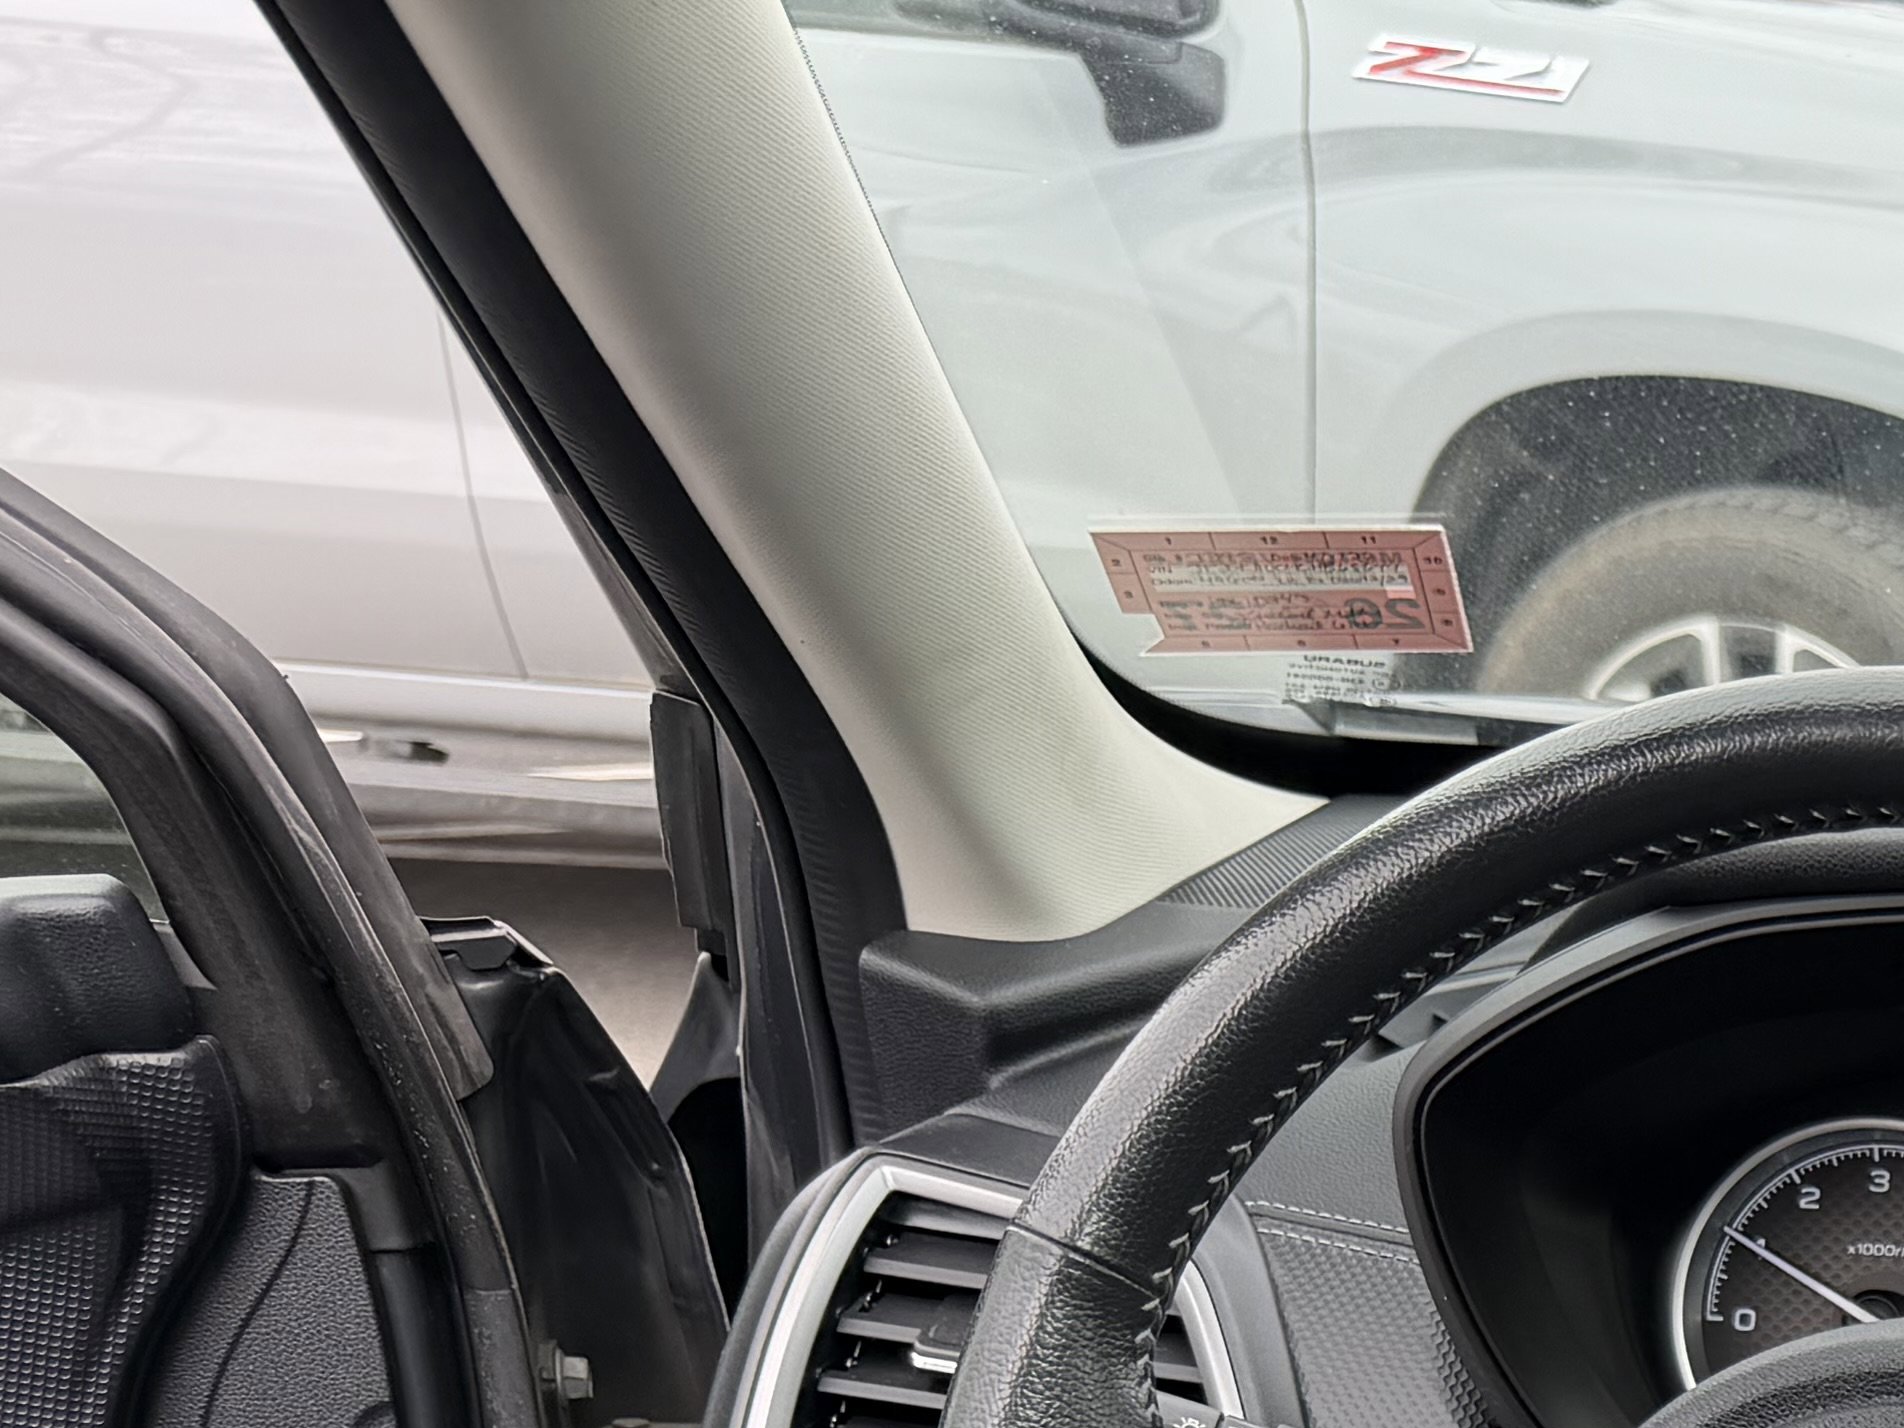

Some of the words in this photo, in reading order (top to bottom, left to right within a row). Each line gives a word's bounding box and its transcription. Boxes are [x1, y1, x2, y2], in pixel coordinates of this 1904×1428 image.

[1869, 1169, 1891, 1193] 3
[1798, 1187, 1822, 1210] 2
[1733, 1308, 1757, 1332] 0
